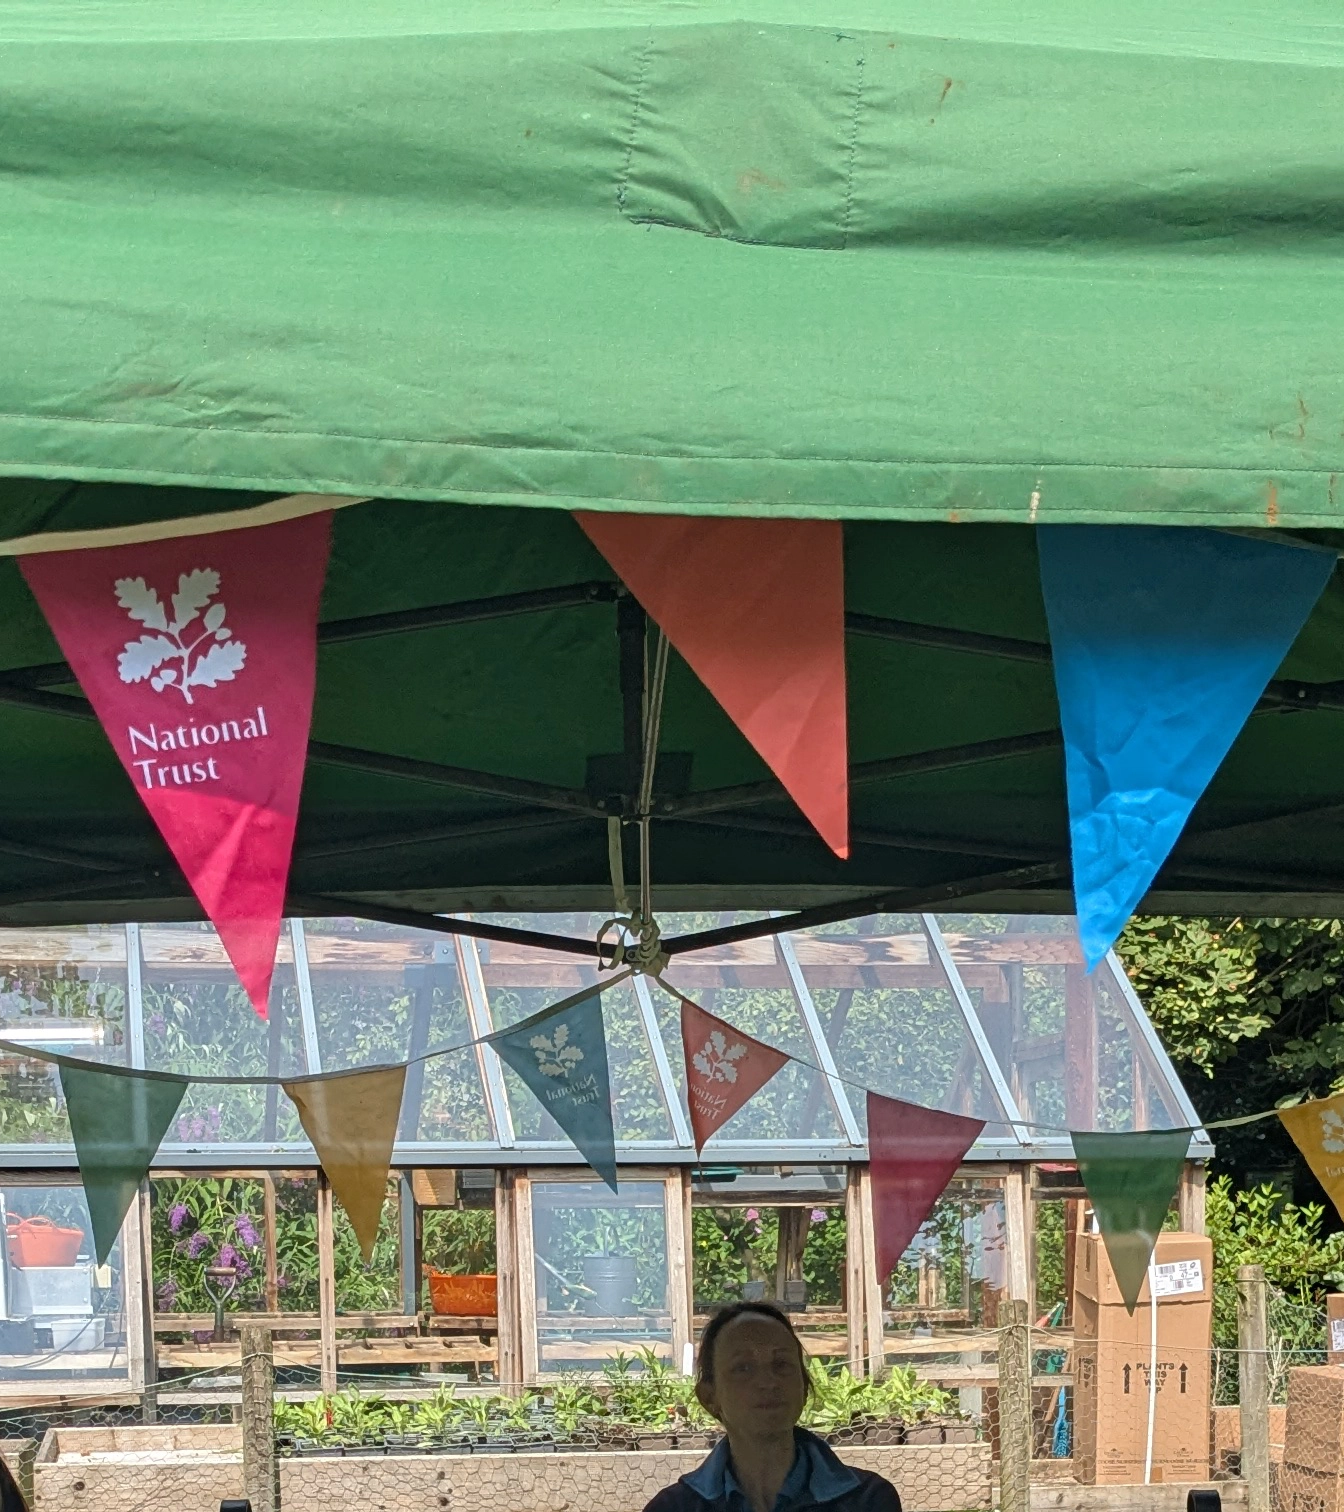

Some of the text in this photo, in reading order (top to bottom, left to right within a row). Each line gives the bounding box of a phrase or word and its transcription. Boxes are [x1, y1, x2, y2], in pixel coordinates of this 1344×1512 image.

[128, 706, 268, 755] National
[132, 757, 220, 790] Trust
[1144, 1370, 1167, 1379] TIS
